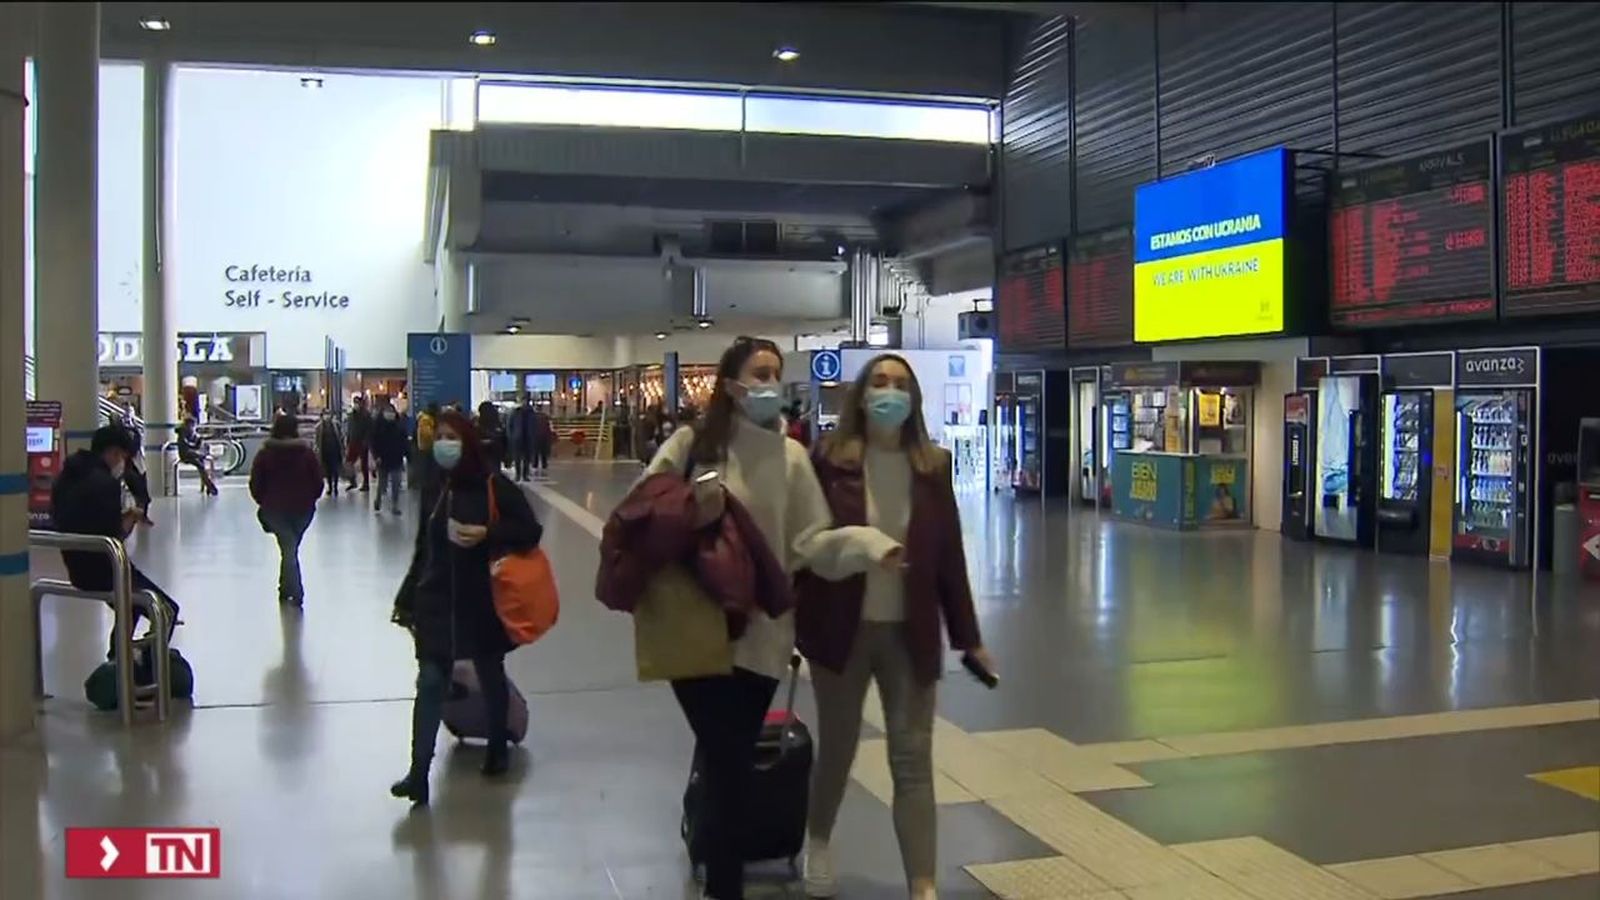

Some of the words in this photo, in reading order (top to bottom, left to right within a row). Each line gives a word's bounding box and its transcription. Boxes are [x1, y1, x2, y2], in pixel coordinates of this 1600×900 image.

[1150, 228, 1192, 250] ESTAMOS
[1193, 224, 1214, 242] CON
[1215, 214, 1261, 237] UCRANIA
[225, 264, 312, 282] Cafetería
[1153, 272, 1167, 286] WE
[1168, 269, 1185, 284] ARE
[1188, 266, 1213, 281] WITH
[1215, 258, 1260, 277] UKRAINE
[225, 290, 260, 307] Self
[282, 291, 349, 308] Service
[1466, 357, 1516, 372] avanza
